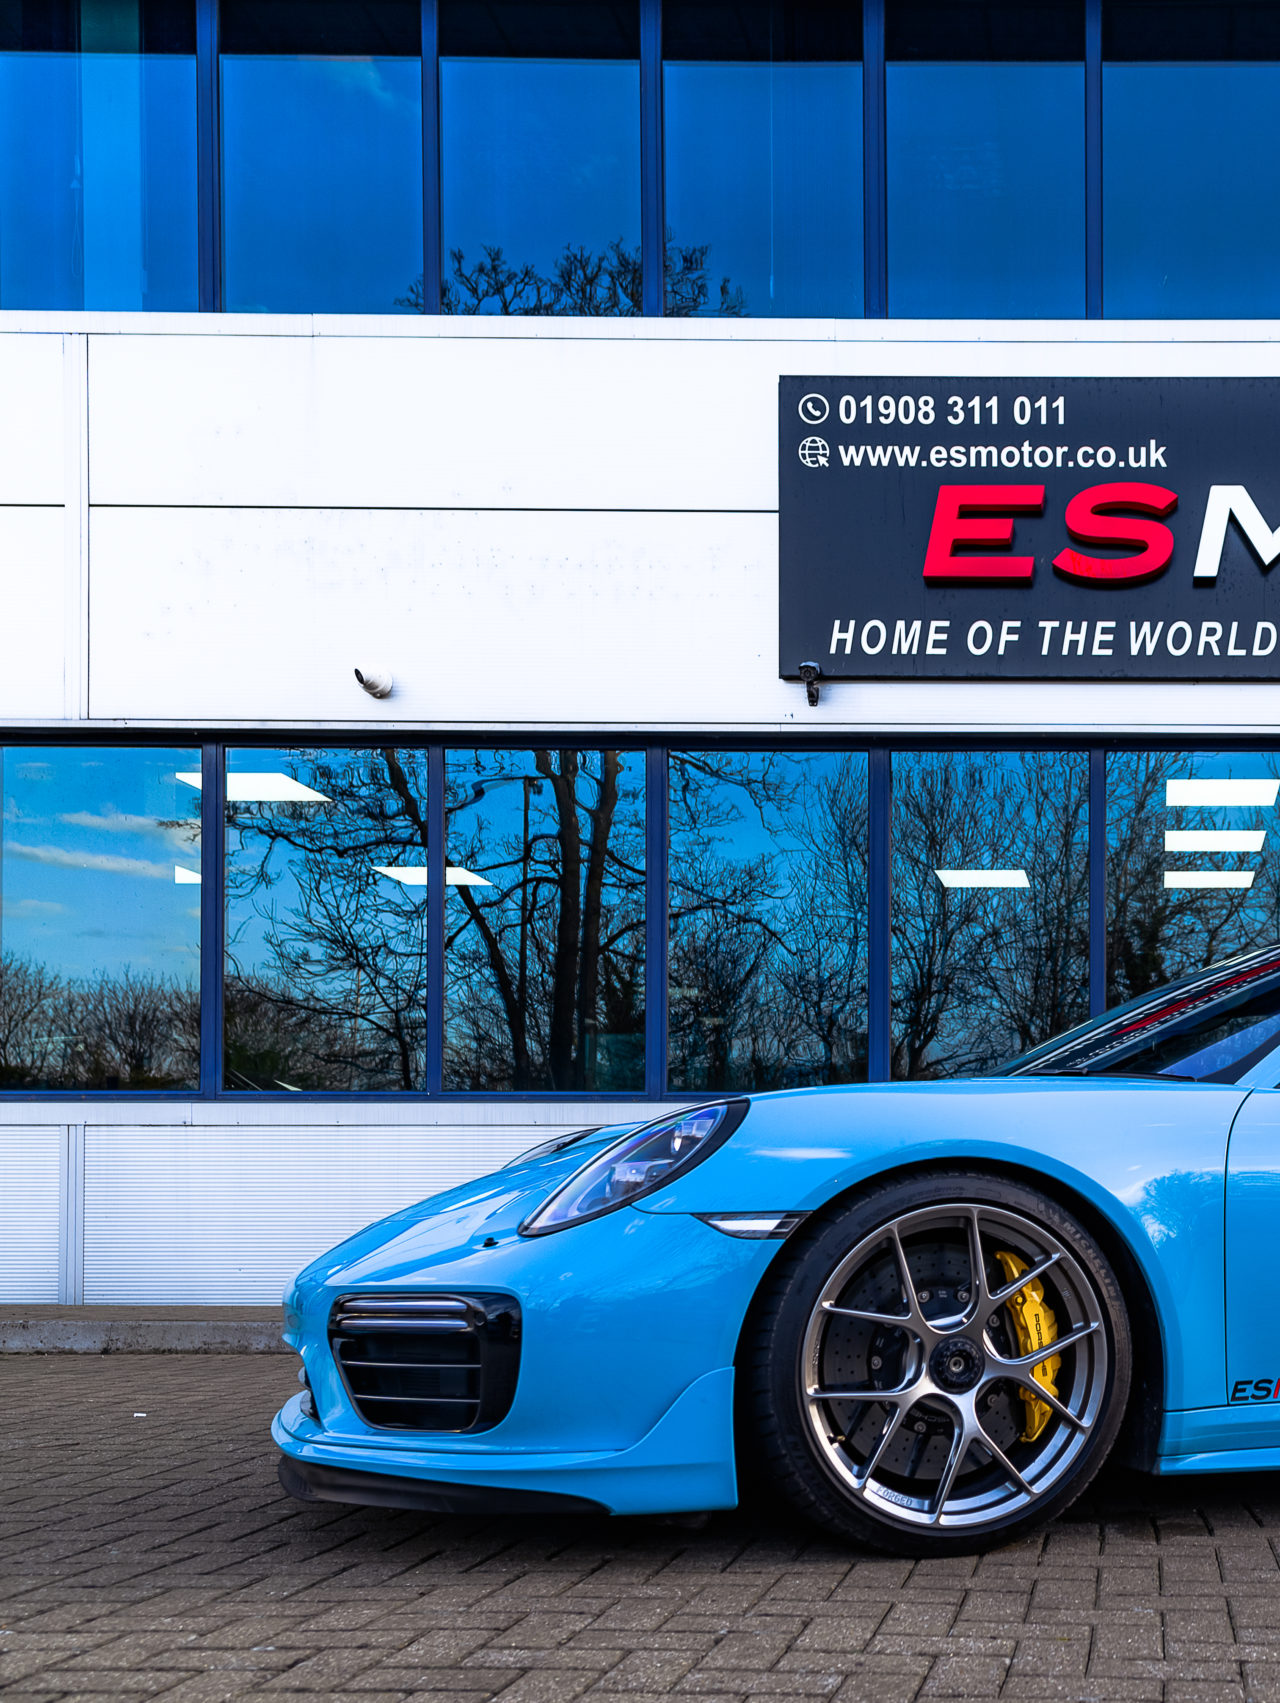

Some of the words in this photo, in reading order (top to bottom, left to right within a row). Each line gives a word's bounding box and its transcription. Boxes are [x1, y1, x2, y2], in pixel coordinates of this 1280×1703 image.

[838, 394, 936, 425] 01908
[947, 394, 998, 425] 311
[1013, 394, 1065, 425] 011
[838, 439, 1168, 469] www.esmotor.co.uk
[829, 619, 951, 655] HOME
[967, 620, 1022, 656] OF
[1038, 620, 1117, 656] THE
[1033, 1313, 1048, 1377] PORSHE
[875, 1485, 913, 1508] FORGED
